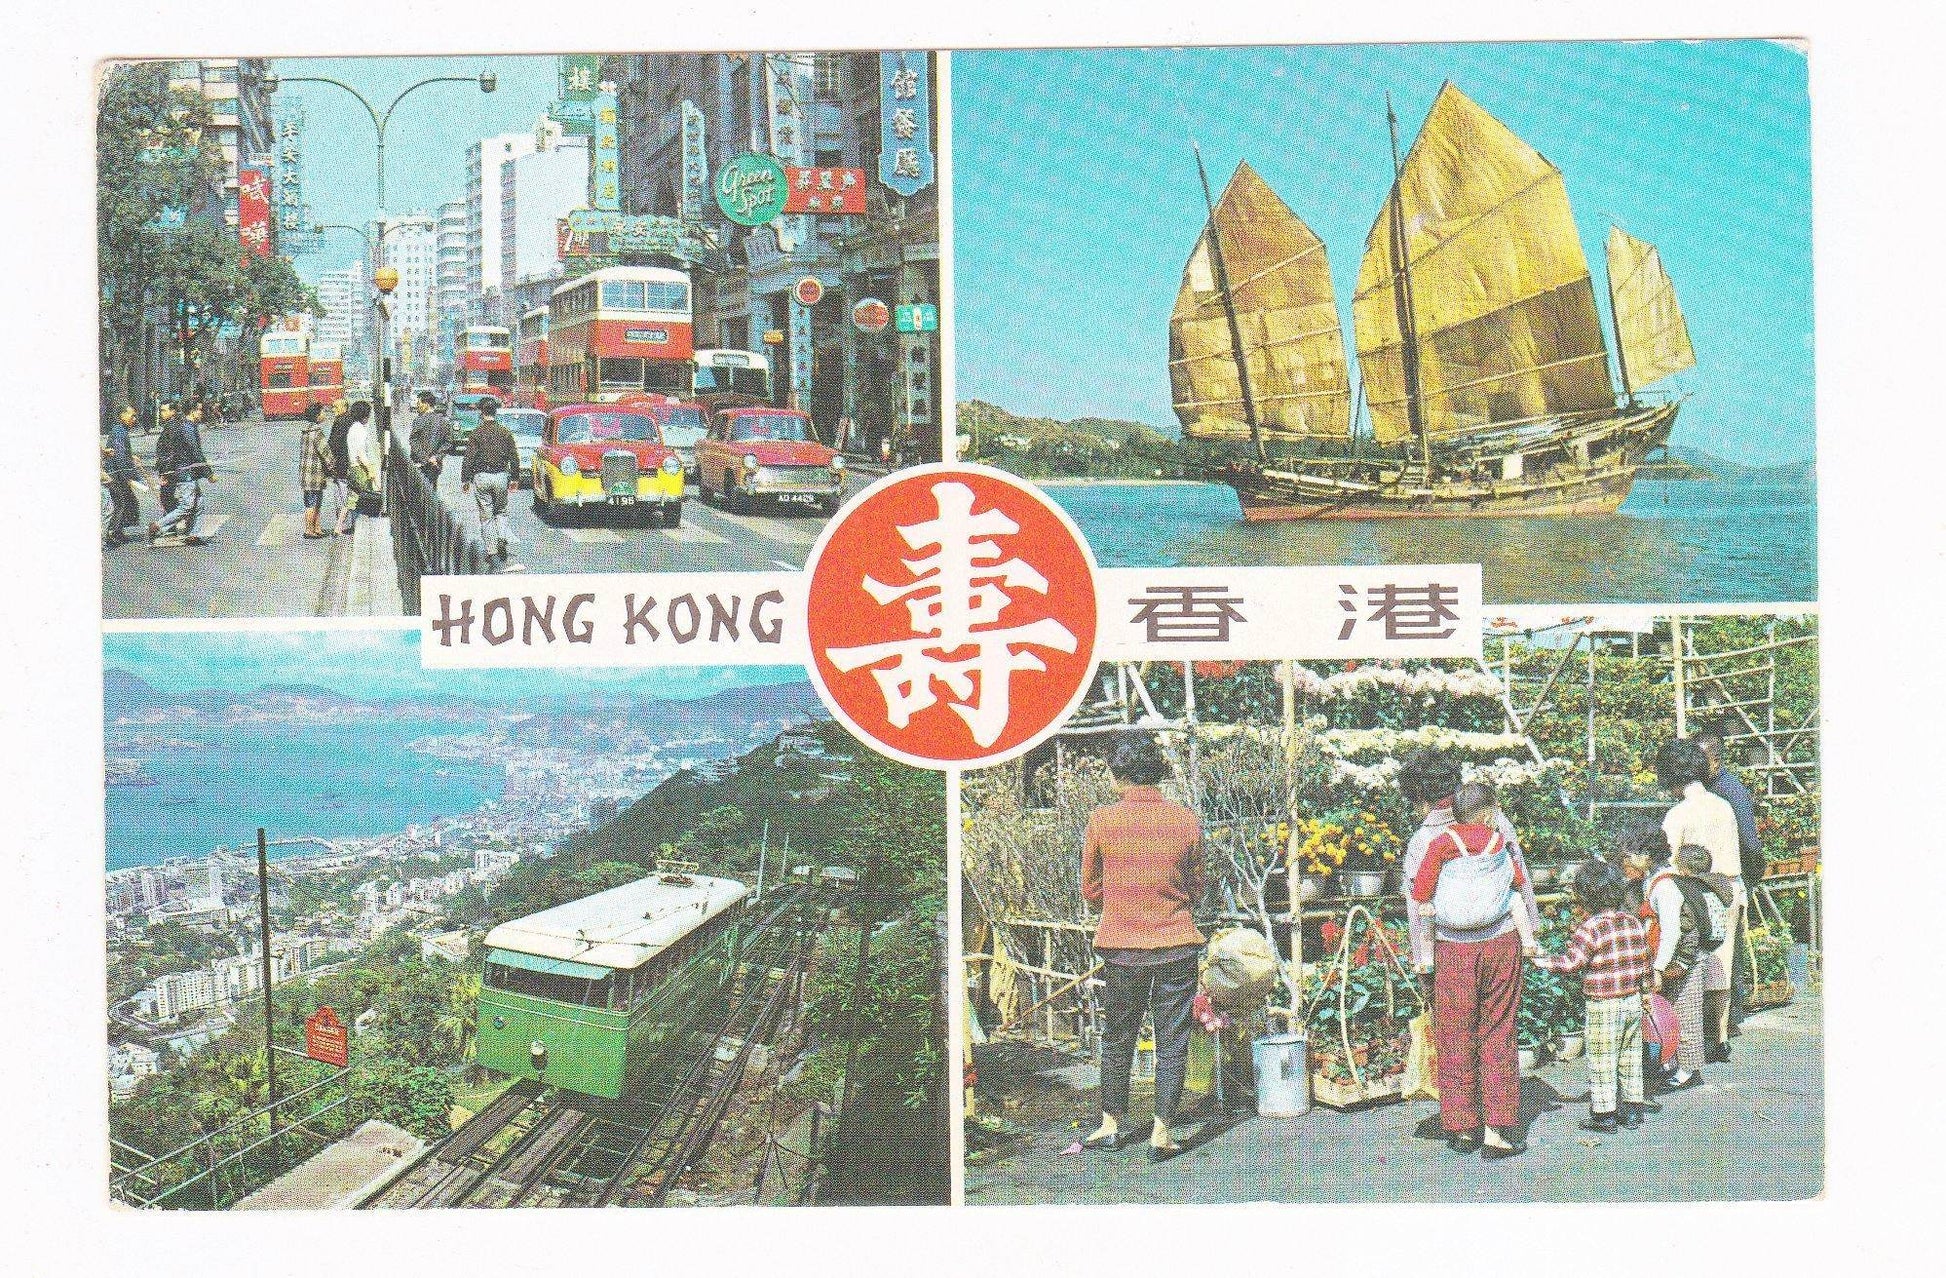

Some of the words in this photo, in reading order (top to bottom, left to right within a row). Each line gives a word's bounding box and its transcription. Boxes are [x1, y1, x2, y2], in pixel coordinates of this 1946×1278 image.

[720, 165, 773, 203] Green
[734, 184, 775, 217] Spot
[432, 594, 595, 648] HONG
[622, 590, 785, 647] KONG
[826, 481, 1078, 747] 壽
[1128, 584, 1460, 642] 香港
